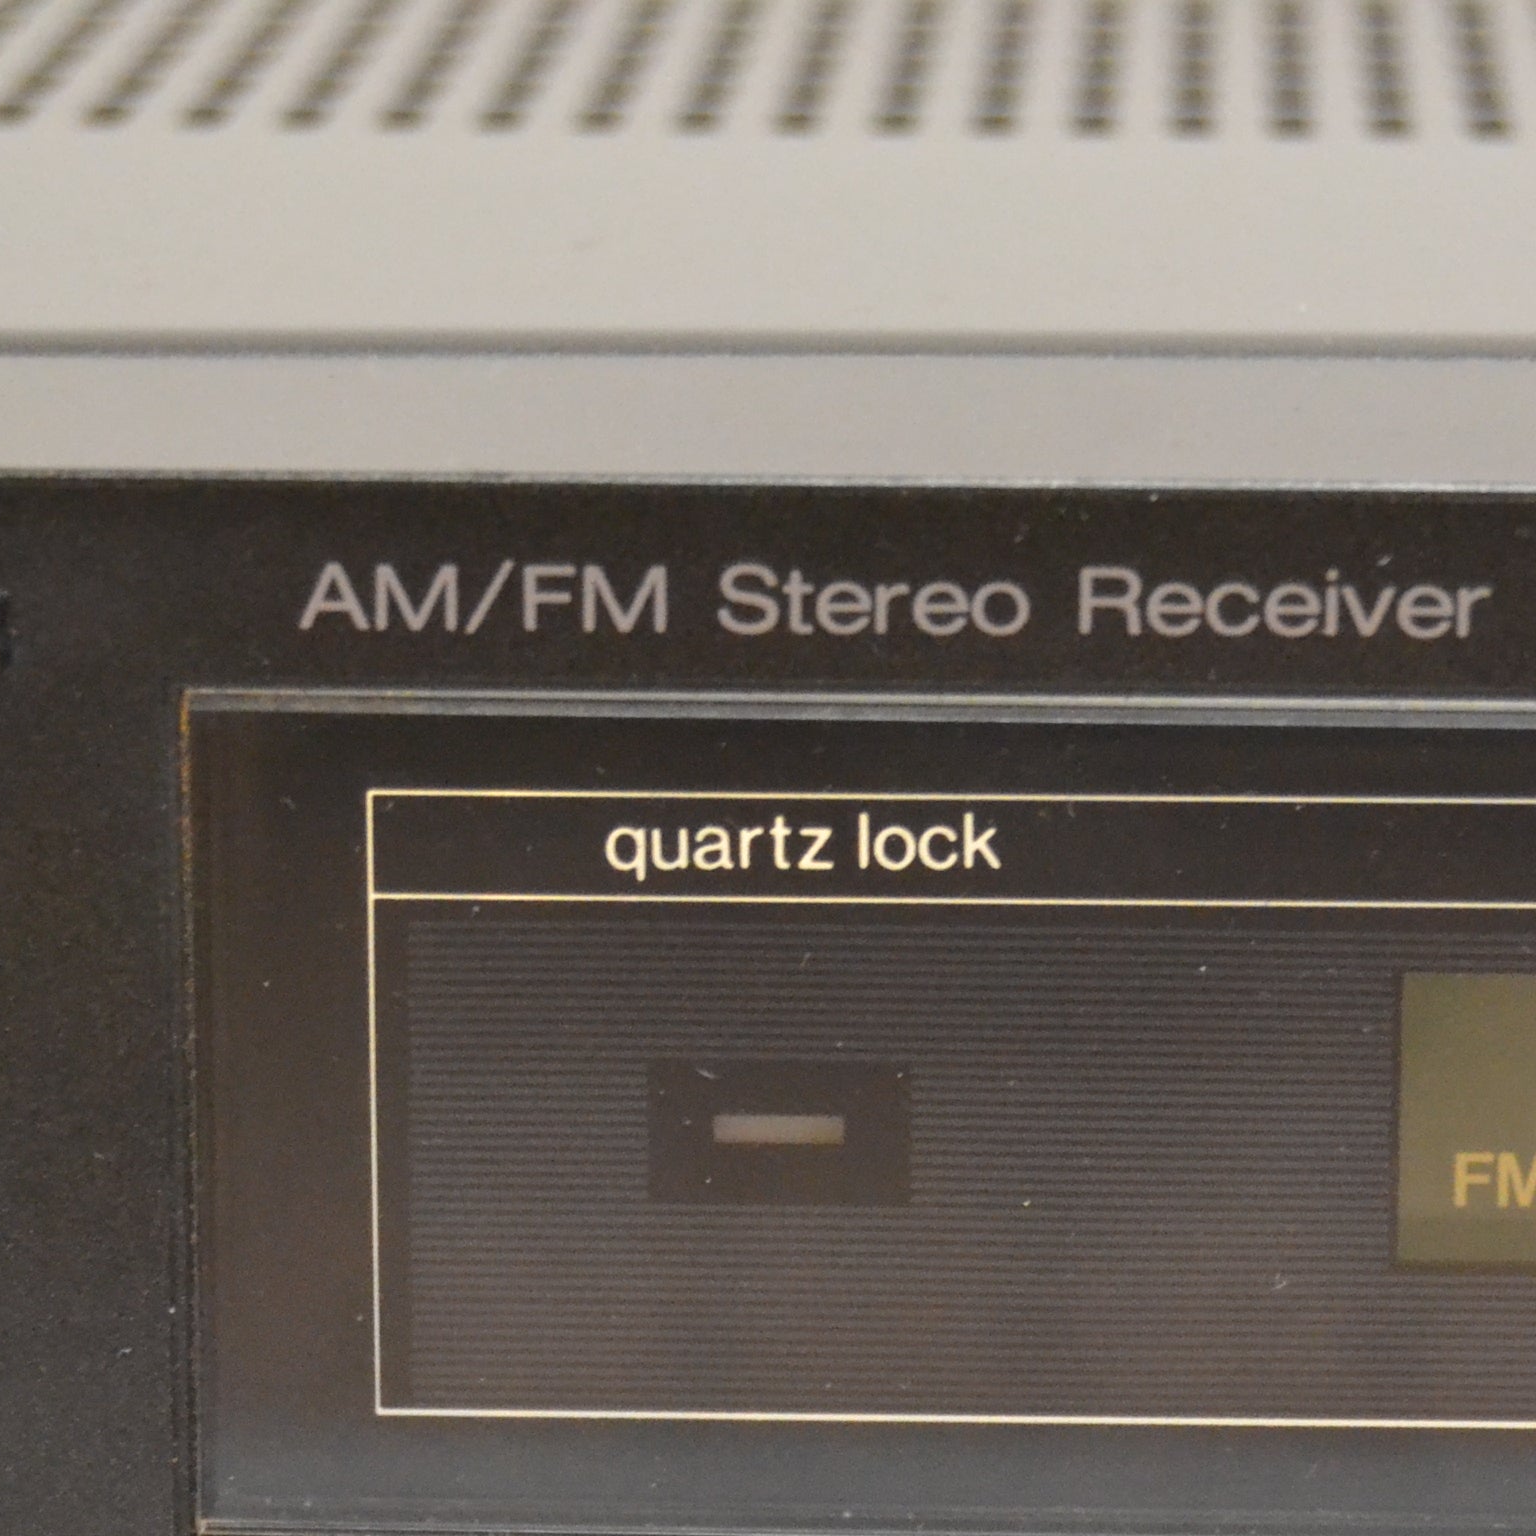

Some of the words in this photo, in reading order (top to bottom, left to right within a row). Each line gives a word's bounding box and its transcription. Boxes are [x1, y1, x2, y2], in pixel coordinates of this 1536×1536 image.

[297, 558, 669, 636] AM/FM
[716, 561, 1032, 638] Stereo
[1077, 564, 1493, 641] Receiver
[603, 814, 835, 883] quartz
[857, 811, 1002, 872] lock
